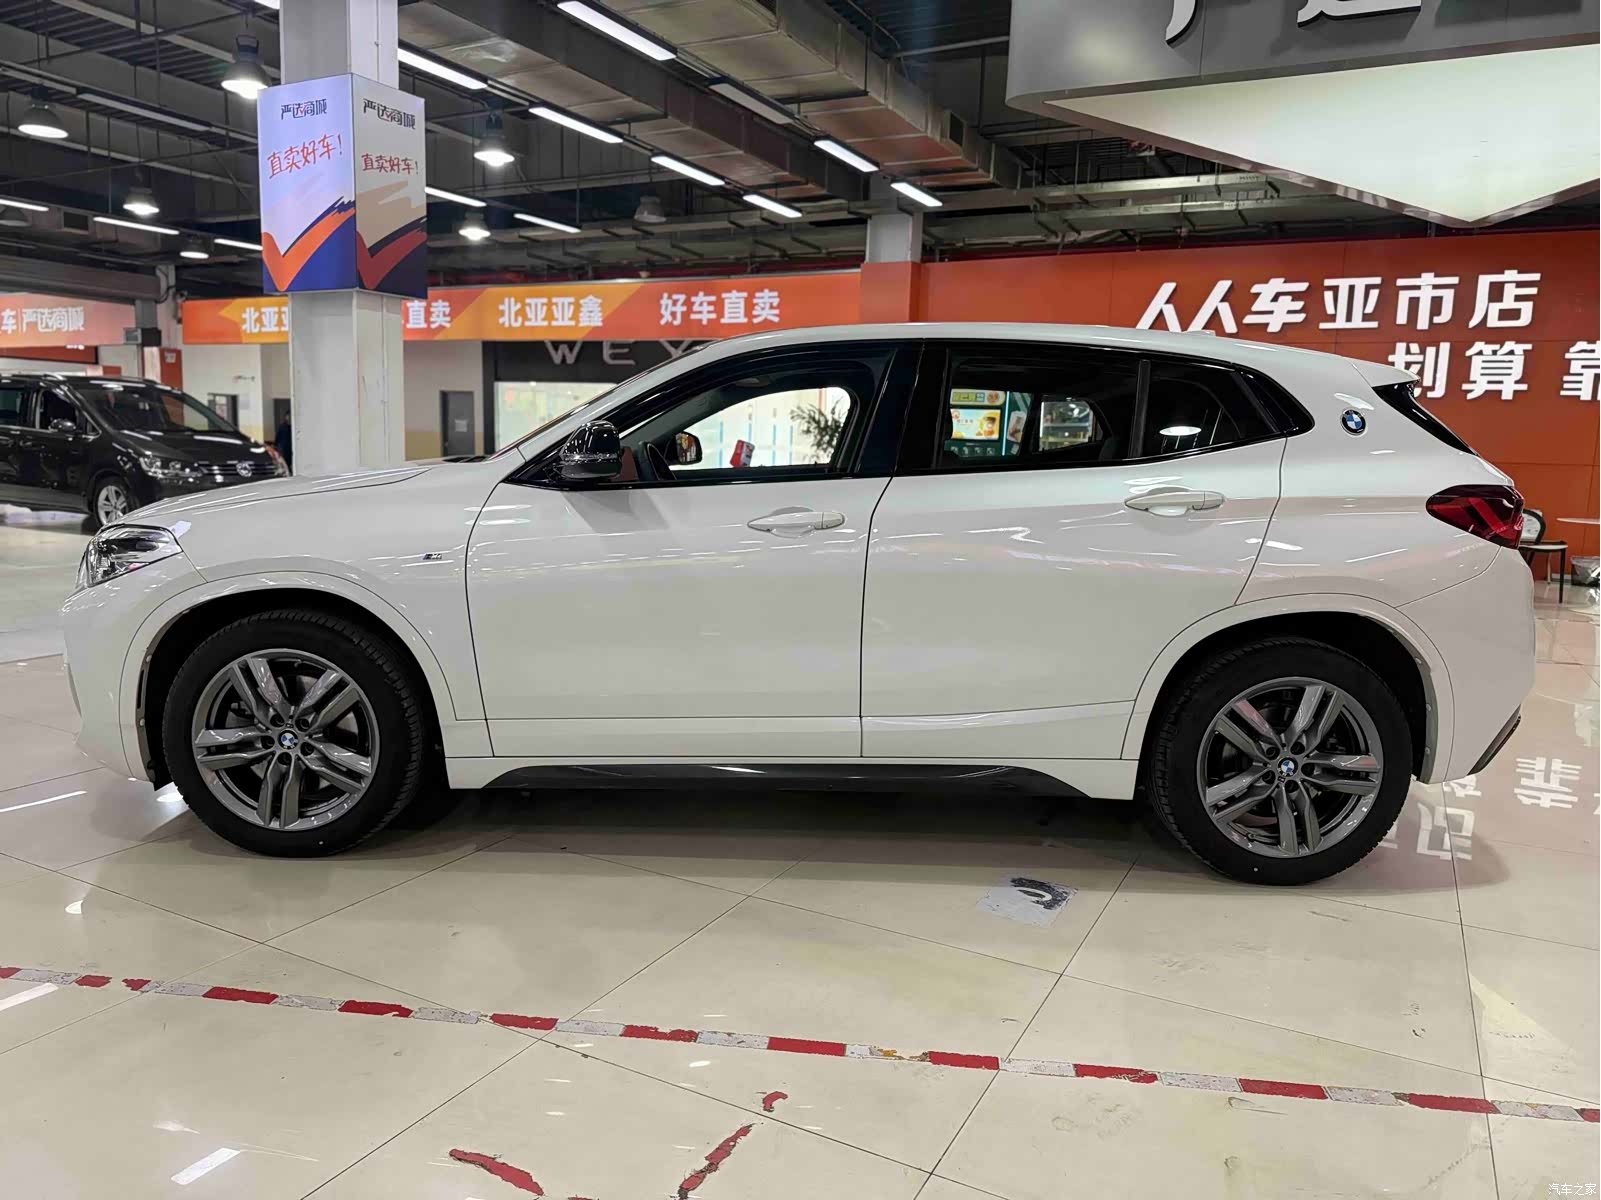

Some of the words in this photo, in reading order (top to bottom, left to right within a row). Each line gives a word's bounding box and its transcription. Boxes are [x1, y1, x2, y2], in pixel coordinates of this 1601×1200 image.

[281, 99, 327, 120] 严选商城
[363, 98, 416, 129] 严选商城
[402, 300, 451, 329] 直卖
[498, 294, 603, 328] 北亚亚鑫
[659, 288, 781, 326] 好车直卖
